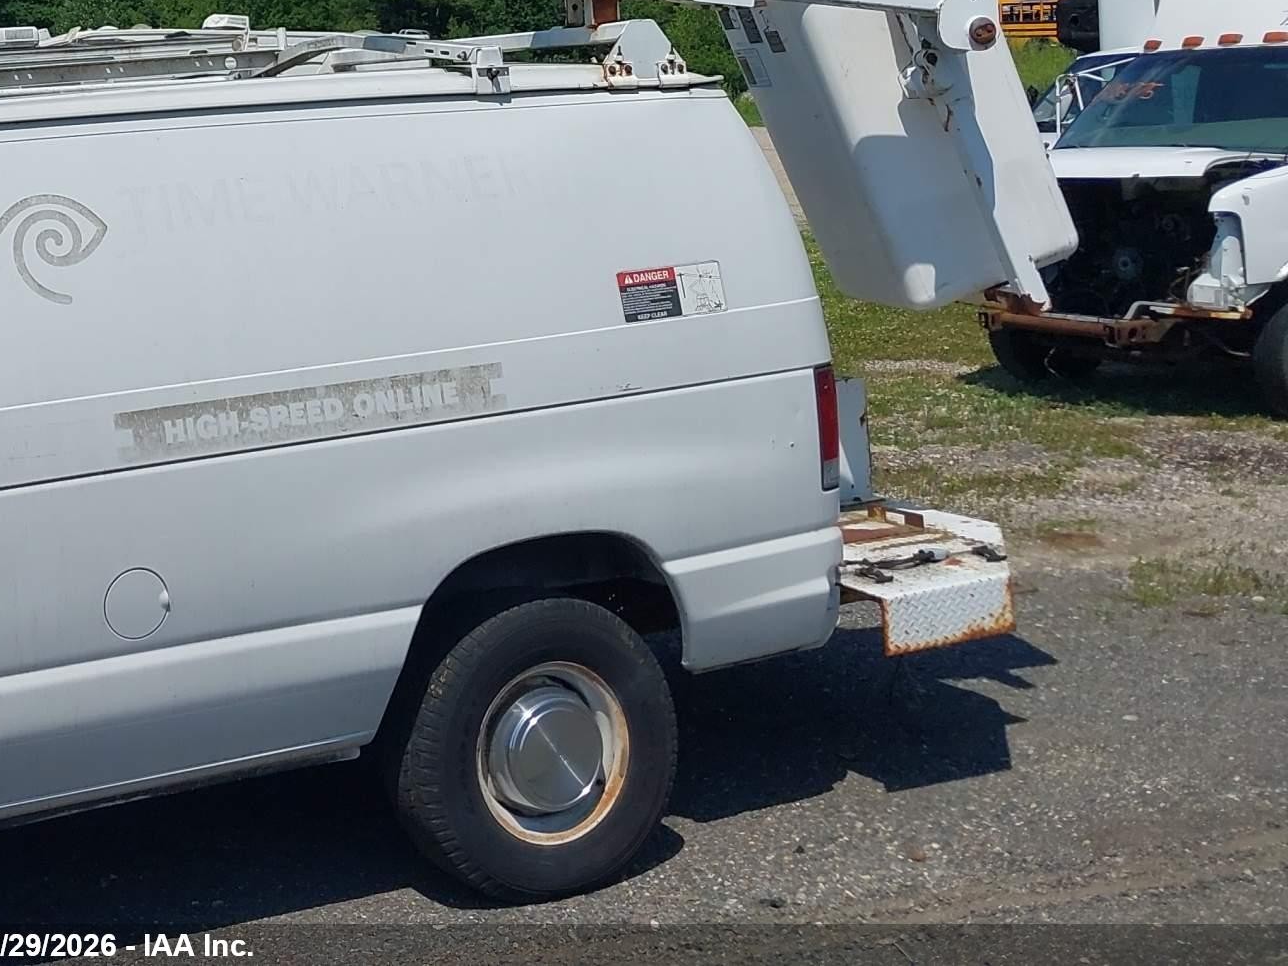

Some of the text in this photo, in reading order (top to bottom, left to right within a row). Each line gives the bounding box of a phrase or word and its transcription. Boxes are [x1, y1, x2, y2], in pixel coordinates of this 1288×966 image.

[633, 270, 669, 283] DANGER
[162, 379, 460, 445] HIGH-SPEED ONLINE
